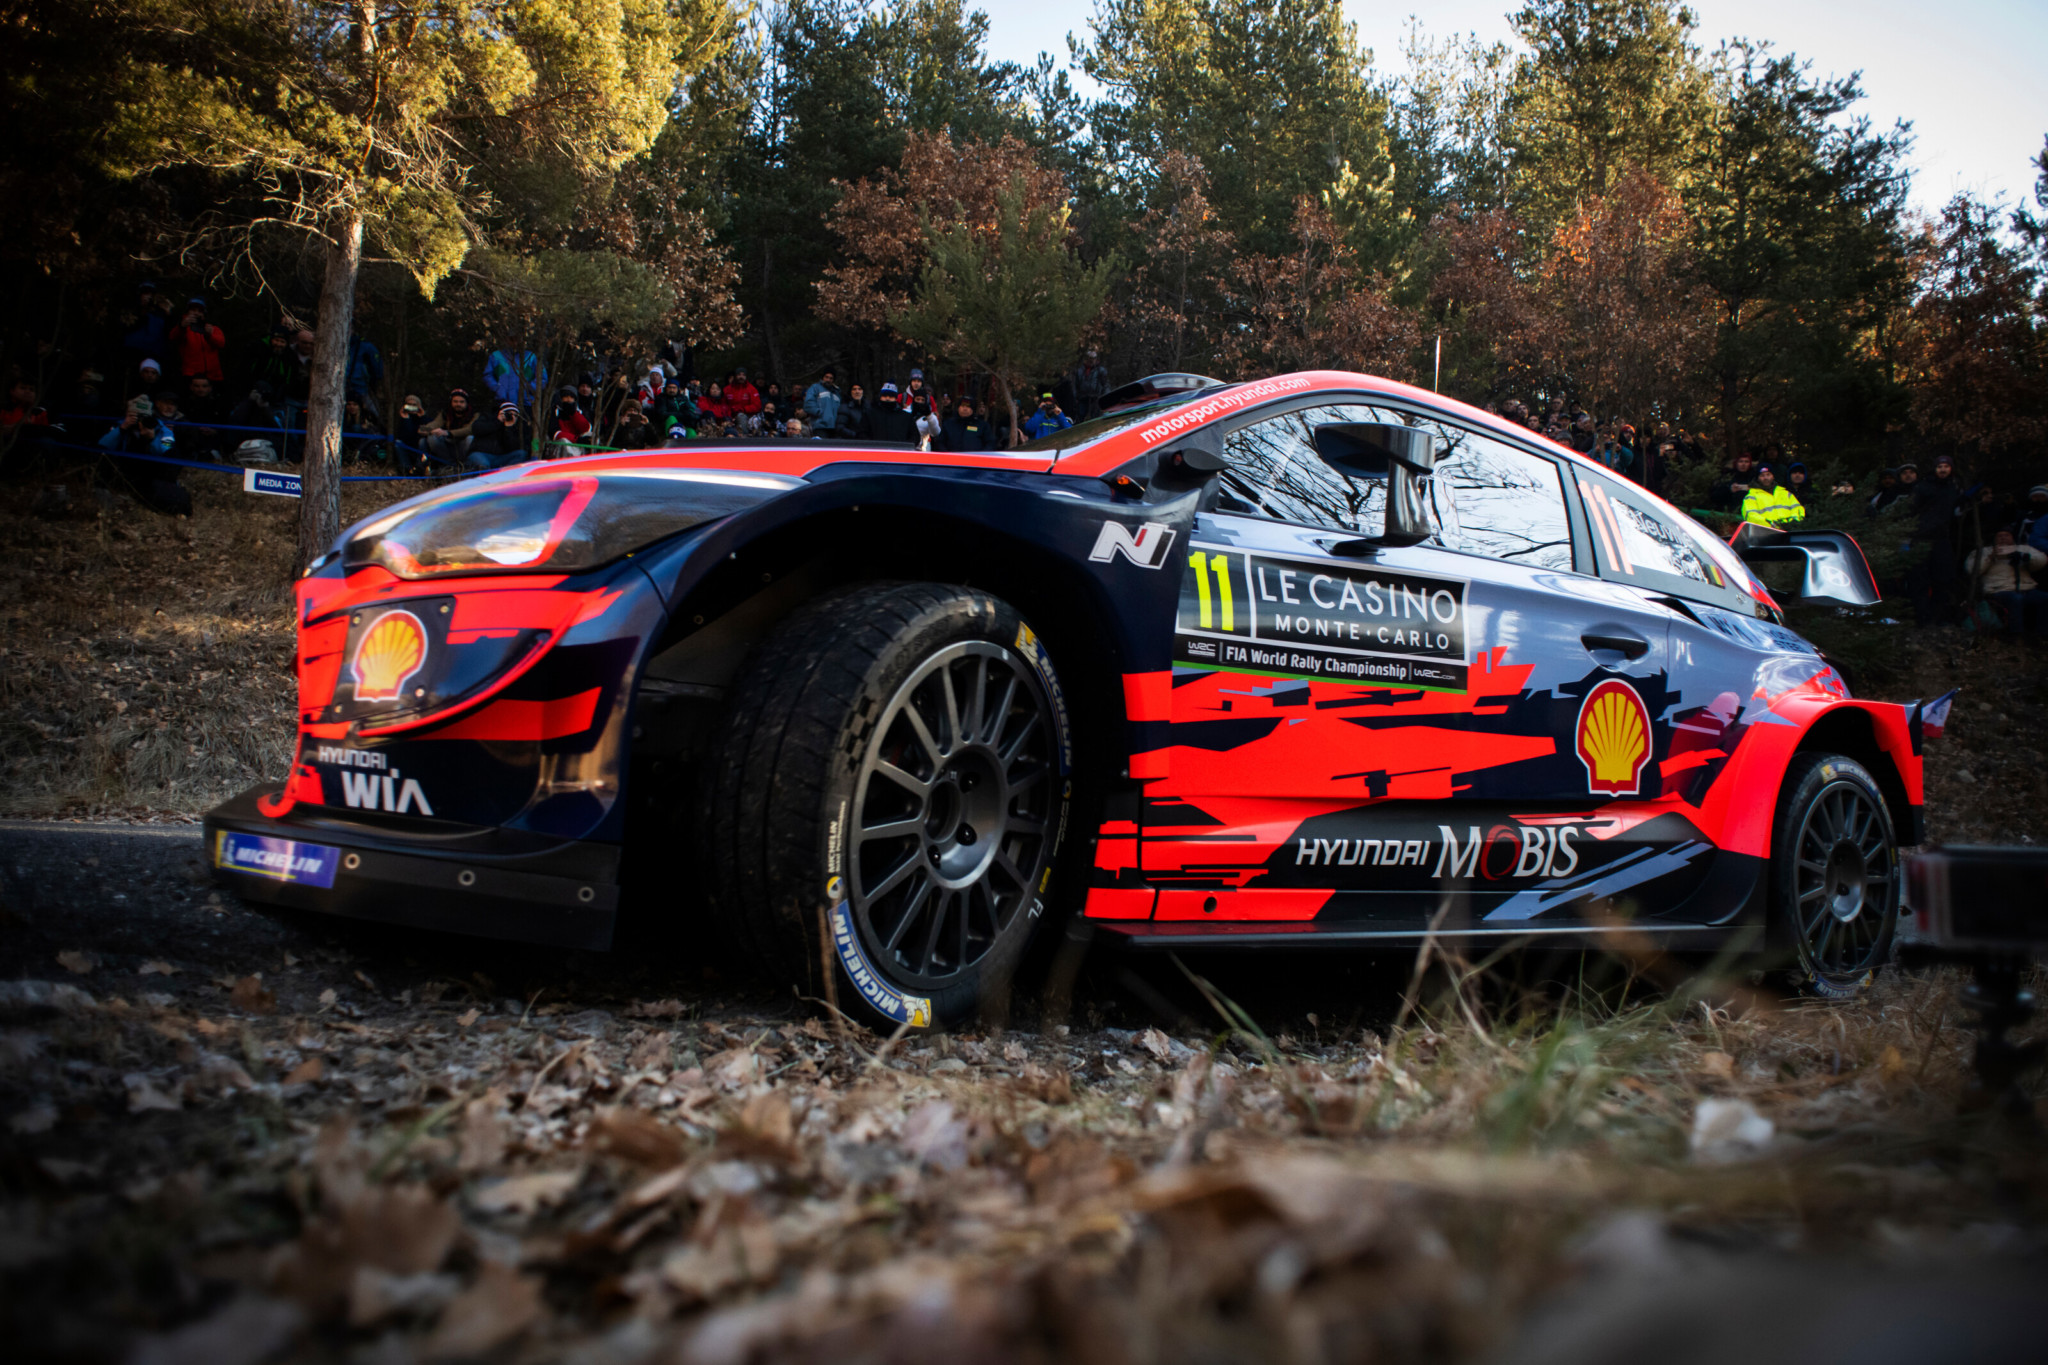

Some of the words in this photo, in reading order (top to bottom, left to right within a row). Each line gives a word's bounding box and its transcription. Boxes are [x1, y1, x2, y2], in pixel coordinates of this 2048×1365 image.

[1140, 377, 1311, 444] motorsport.hyundai.com
[258, 477, 284, 489] MEDIA
[1578, 479, 1635, 576] 11
[1188, 551, 1235, 632] 11
[1257, 566, 1301, 605] LE
[1308, 574, 1458, 624] CASINO
[1225, 645, 1249, 664] FIA
[1250, 648, 1288, 667] World
[1290, 652, 1323, 674] Rally
[1324, 657, 1408, 681] Championship
[1040, 655, 1072, 767] MICHELIN
[318, 745, 387, 770] HYUNDAI
[1836, 763, 1877, 791] MICHELIN
[235, 847, 323, 874] MICHELIN
[827, 820, 838, 874] MICHELIN
[1295, 837, 1431, 867] HYUNDAI
[1431, 824, 1582, 881] MOBIS
[1027, 897, 1044, 920] FL
[833, 913, 900, 1015] MICHELIN
